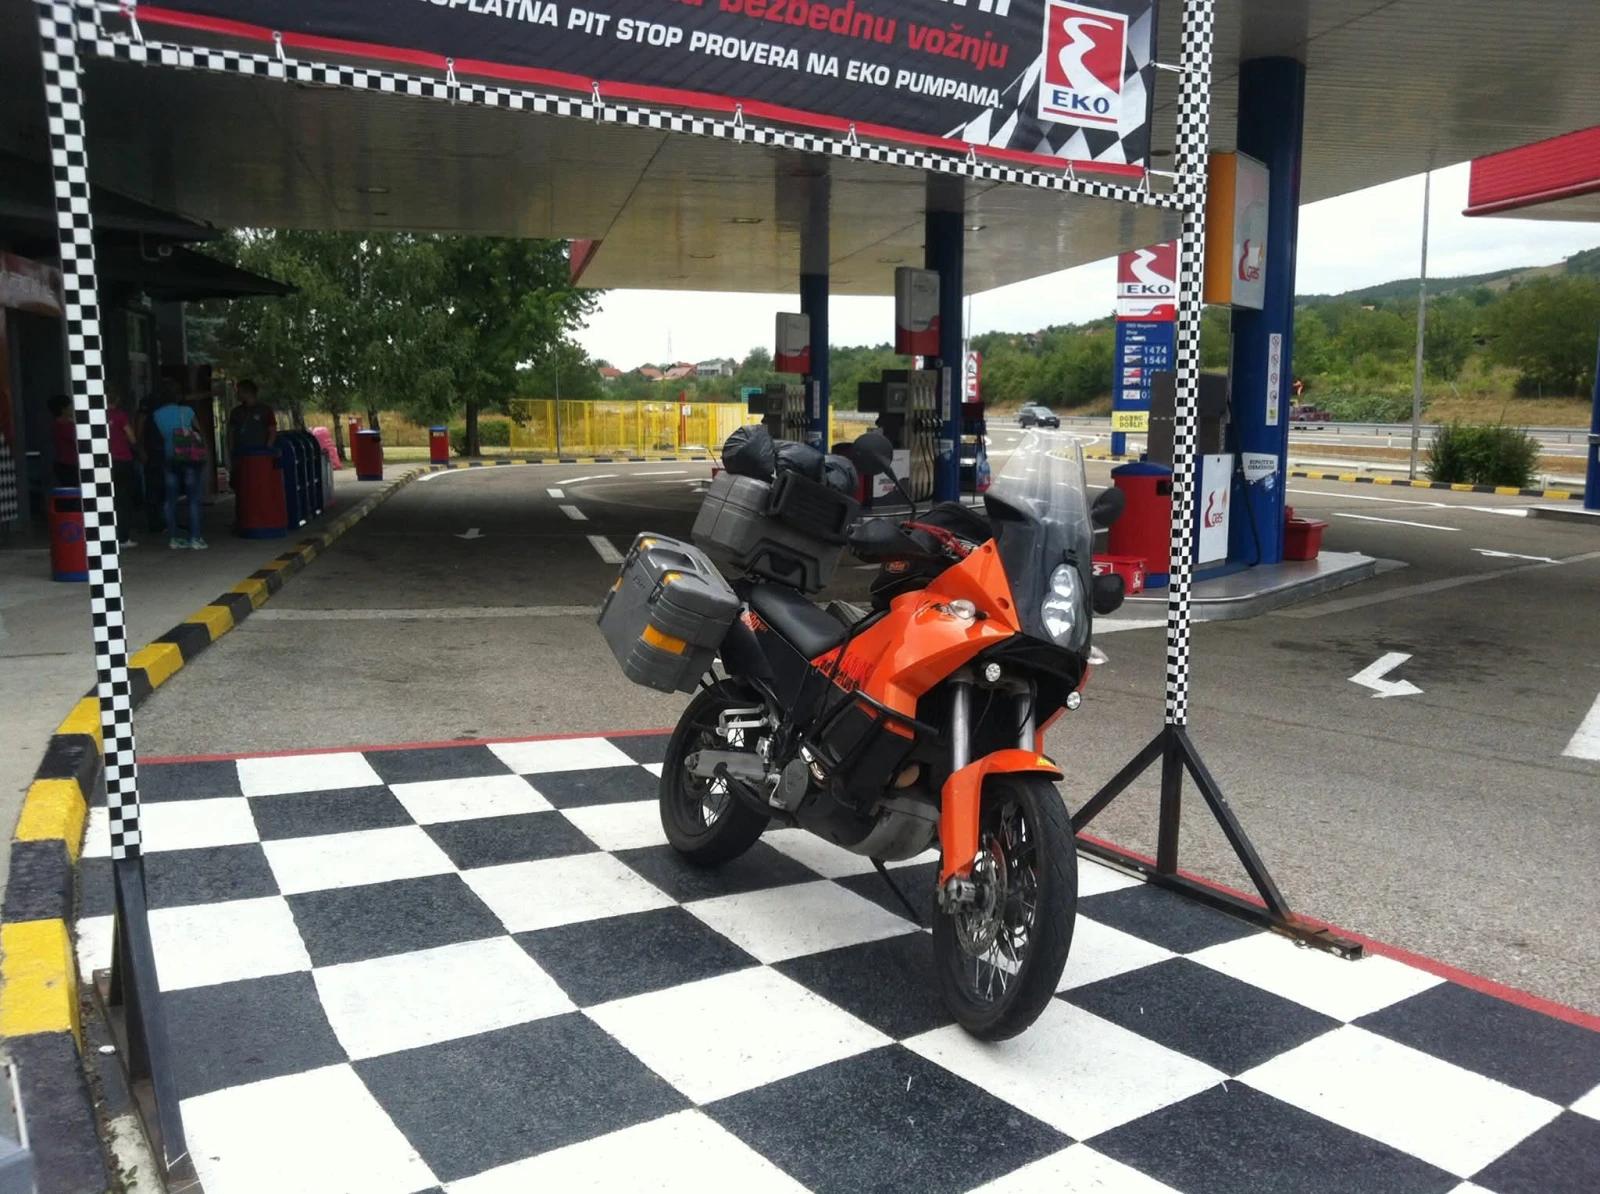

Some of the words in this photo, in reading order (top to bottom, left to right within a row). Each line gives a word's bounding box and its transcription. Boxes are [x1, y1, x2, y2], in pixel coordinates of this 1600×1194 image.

[908, 22, 1009, 70] vožnju
[567, 7, 610, 37] PIT
[616, 18, 684, 48] STOP
[689, 30, 800, 71] PROVERA
[805, 52, 840, 77] NA
[845, 60, 891, 86] EKO
[894, 69, 1004, 109] PUMPAMA.
[1052, 89, 1110, 114] EKO
[1126, 284, 1170, 294] EKO
[1144, 346, 1167, 354] 1474
[1143, 356, 1167, 364] 1544
